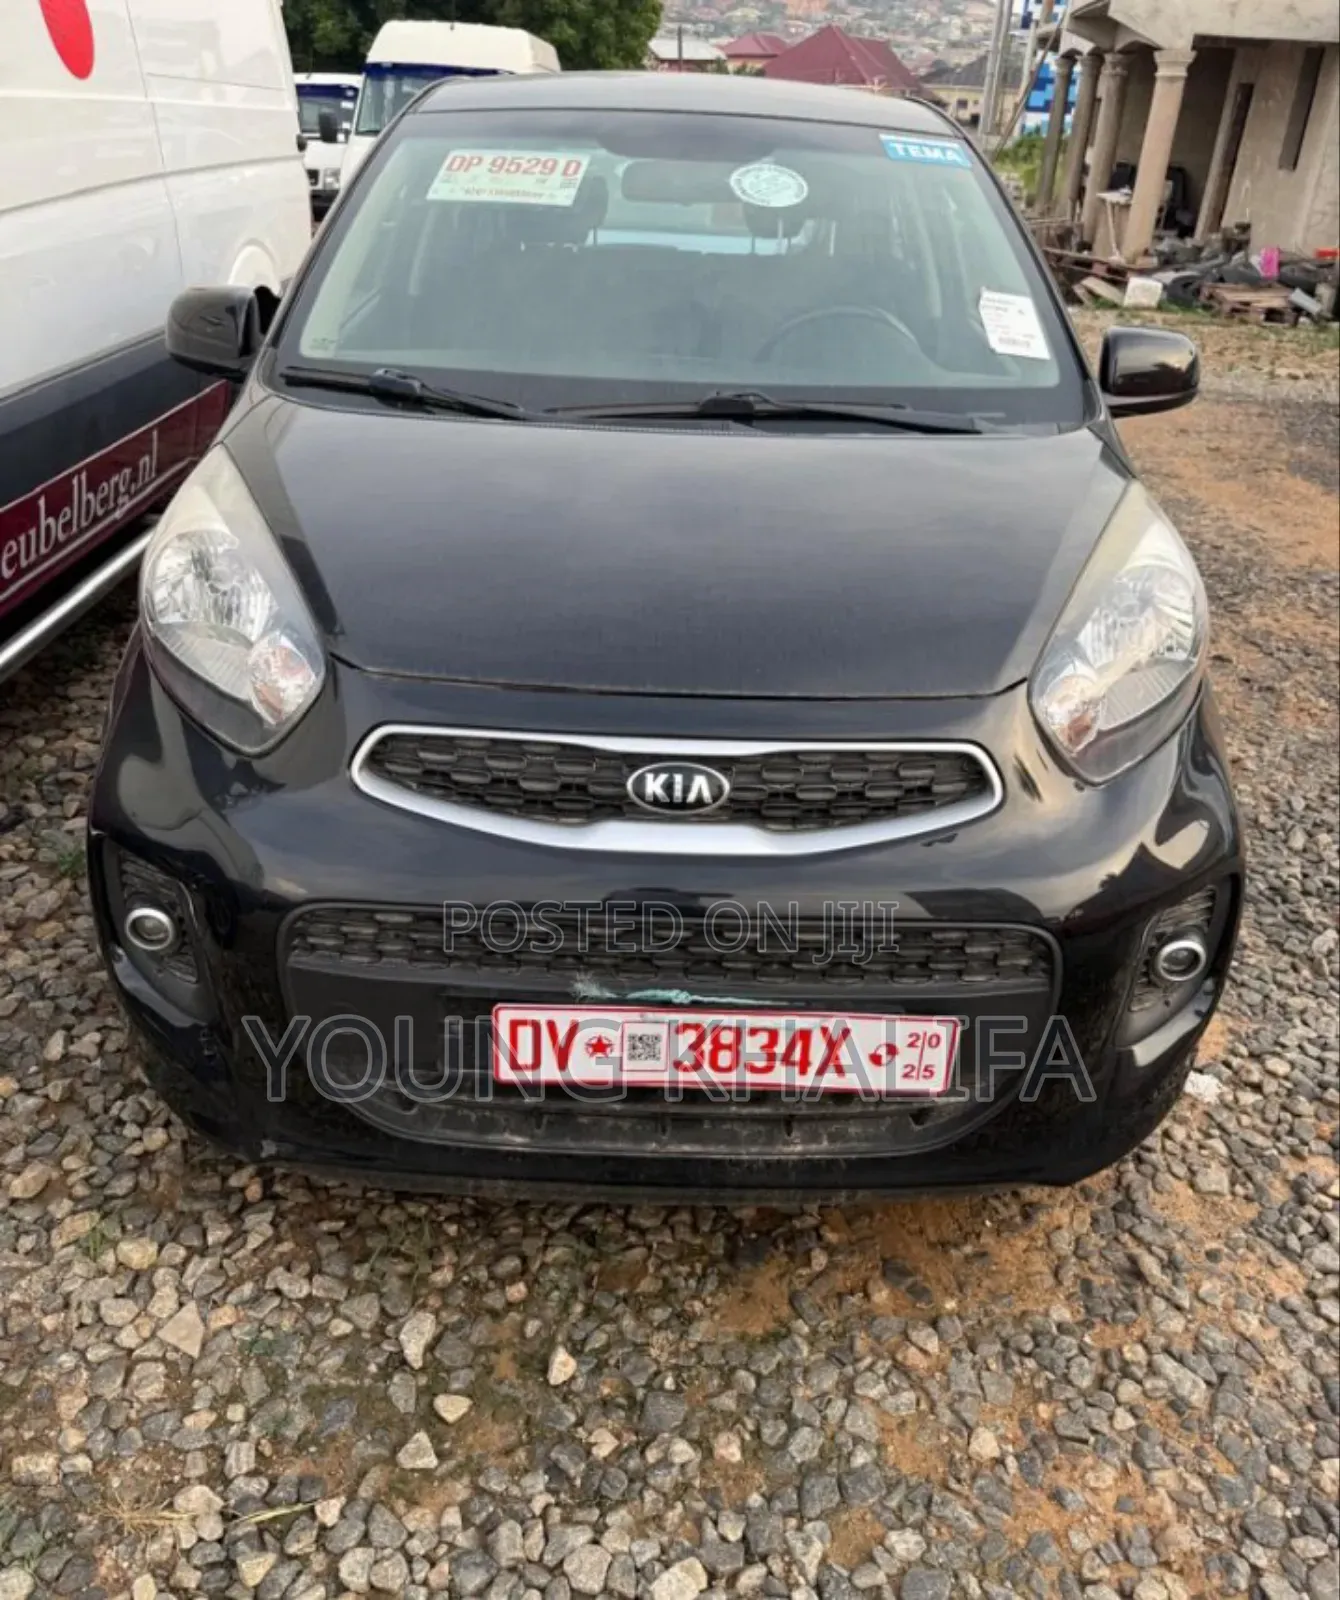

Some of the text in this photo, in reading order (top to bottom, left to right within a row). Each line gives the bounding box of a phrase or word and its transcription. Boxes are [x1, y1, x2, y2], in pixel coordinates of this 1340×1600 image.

[445, 154, 582, 178] DP 9529 D
[889, 142, 963, 163] TEMA
[1, 428, 158, 580] eubelberg.nl
[644, 772, 713, 804] KIA
[508, 1018, 851, 1078] DV 3834X
